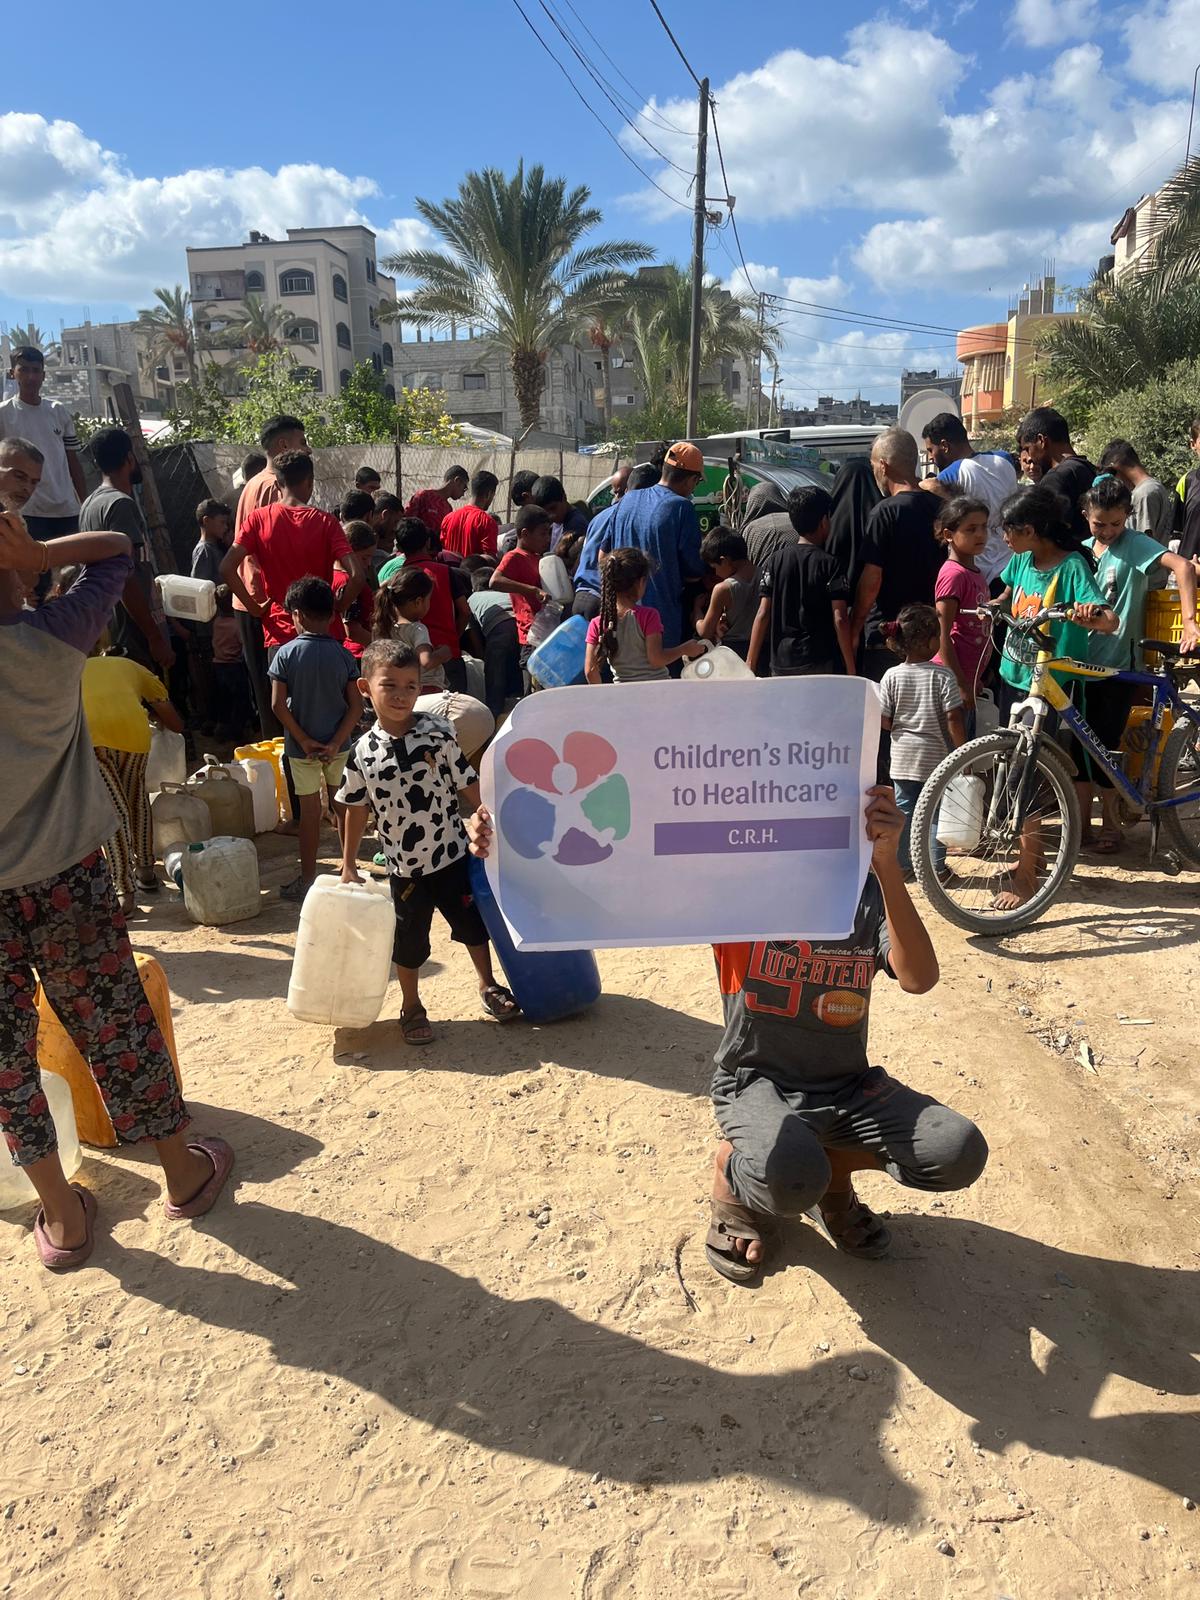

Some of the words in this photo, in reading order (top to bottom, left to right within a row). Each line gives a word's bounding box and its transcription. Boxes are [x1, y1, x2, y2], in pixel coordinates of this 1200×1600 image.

[653, 742, 781, 770] Children's
[787, 741, 852, 770] Right
[672, 785, 697, 807] to
[703, 780, 839, 806] Healthcare
[728, 828, 779, 845] C.R.H.
[812, 944, 852, 956] American
